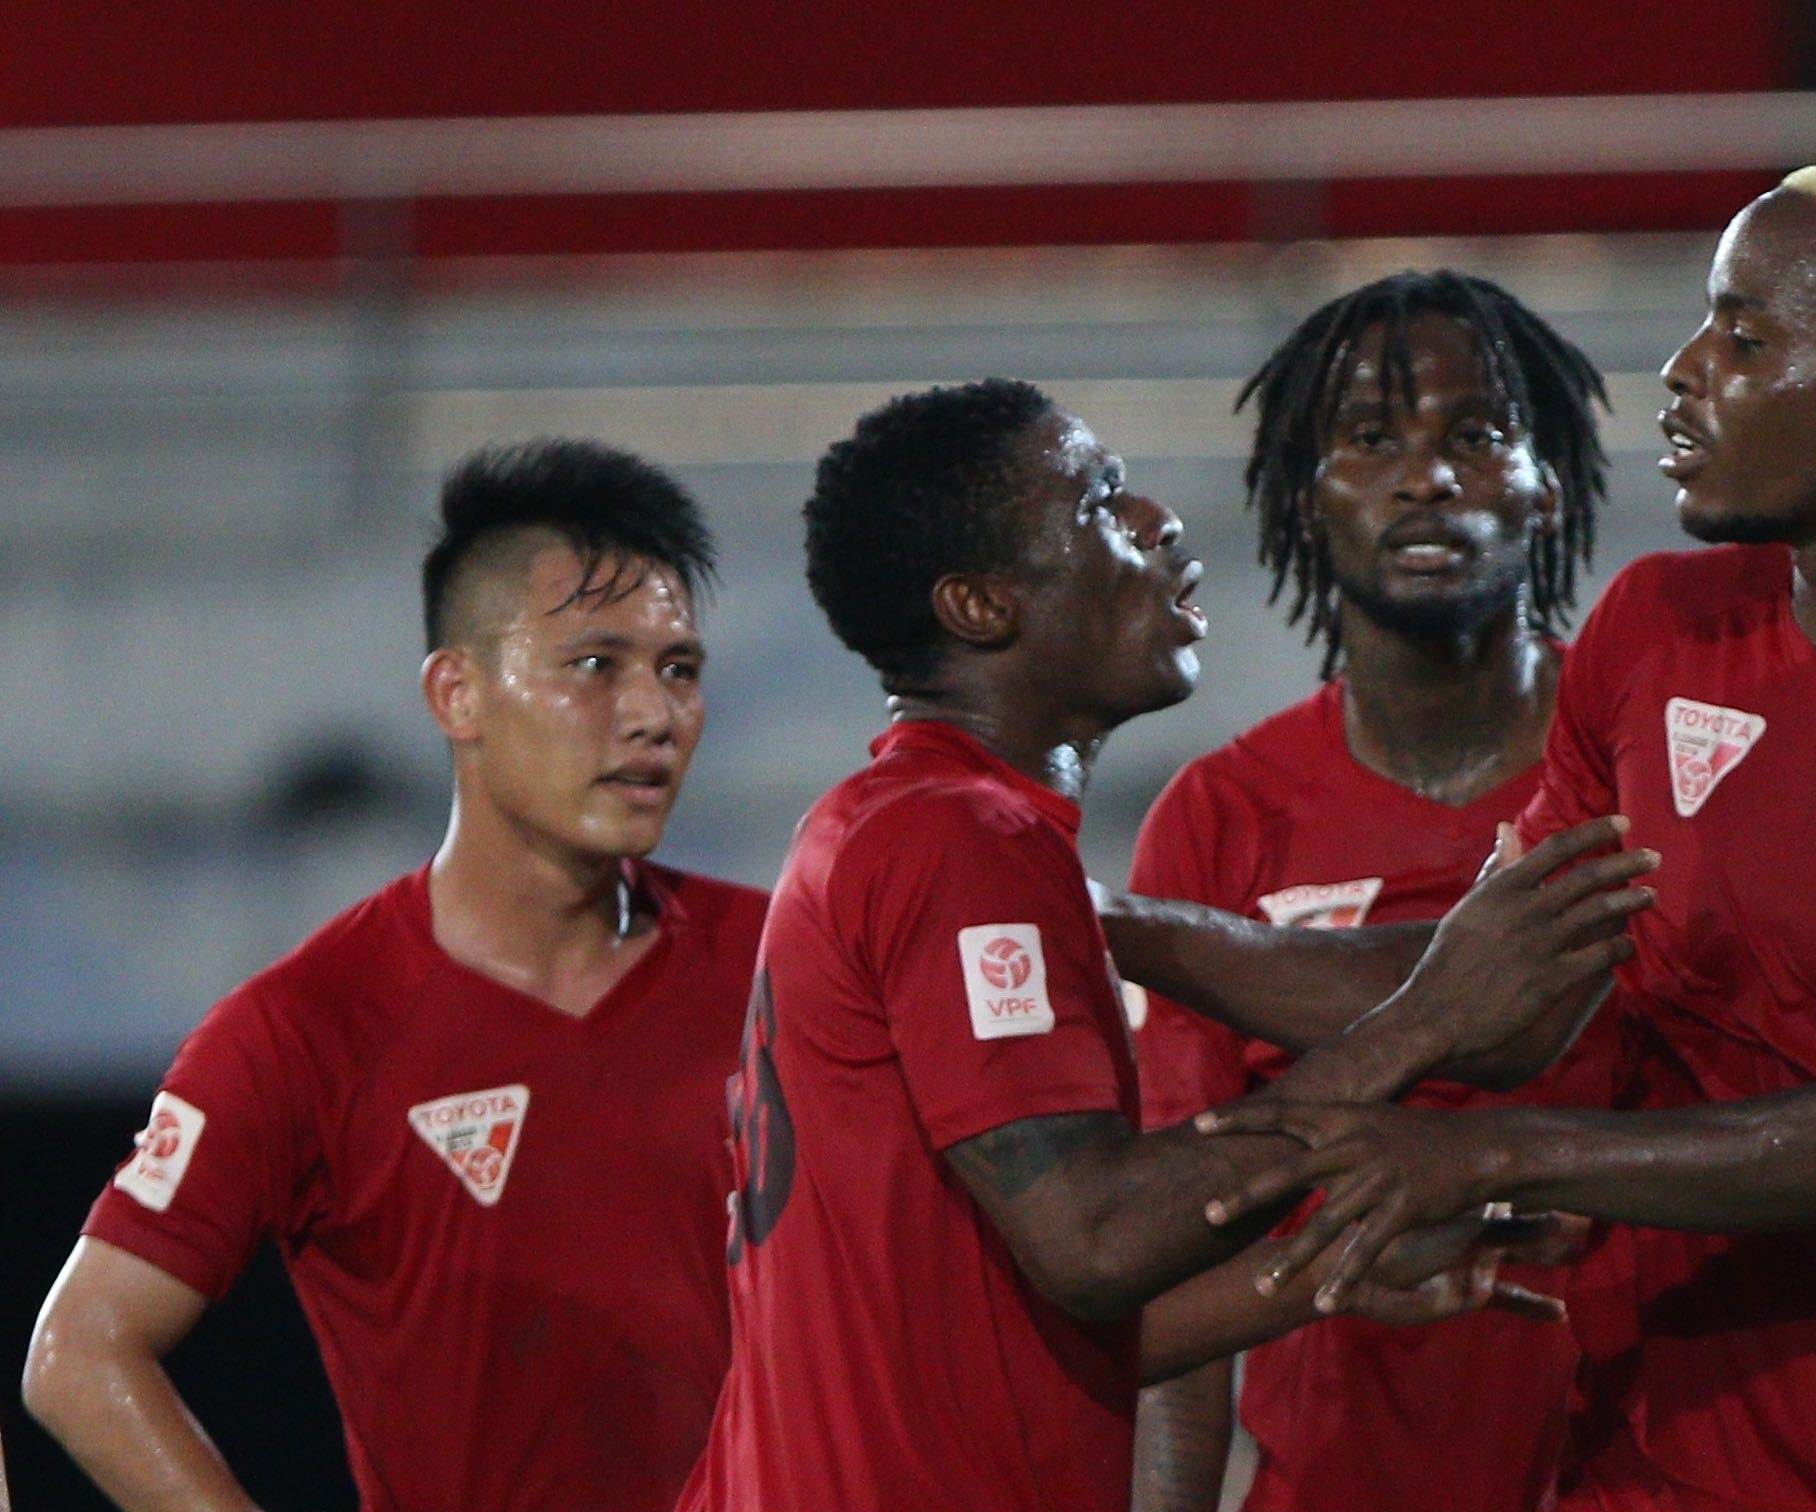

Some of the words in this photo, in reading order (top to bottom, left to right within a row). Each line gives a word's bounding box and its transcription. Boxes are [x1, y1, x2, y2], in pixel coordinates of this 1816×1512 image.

[1674, 705, 1753, 741] TOYOTA
[985, 997, 1037, 1018] VPF
[420, 1095, 517, 1129] TOYOTA
